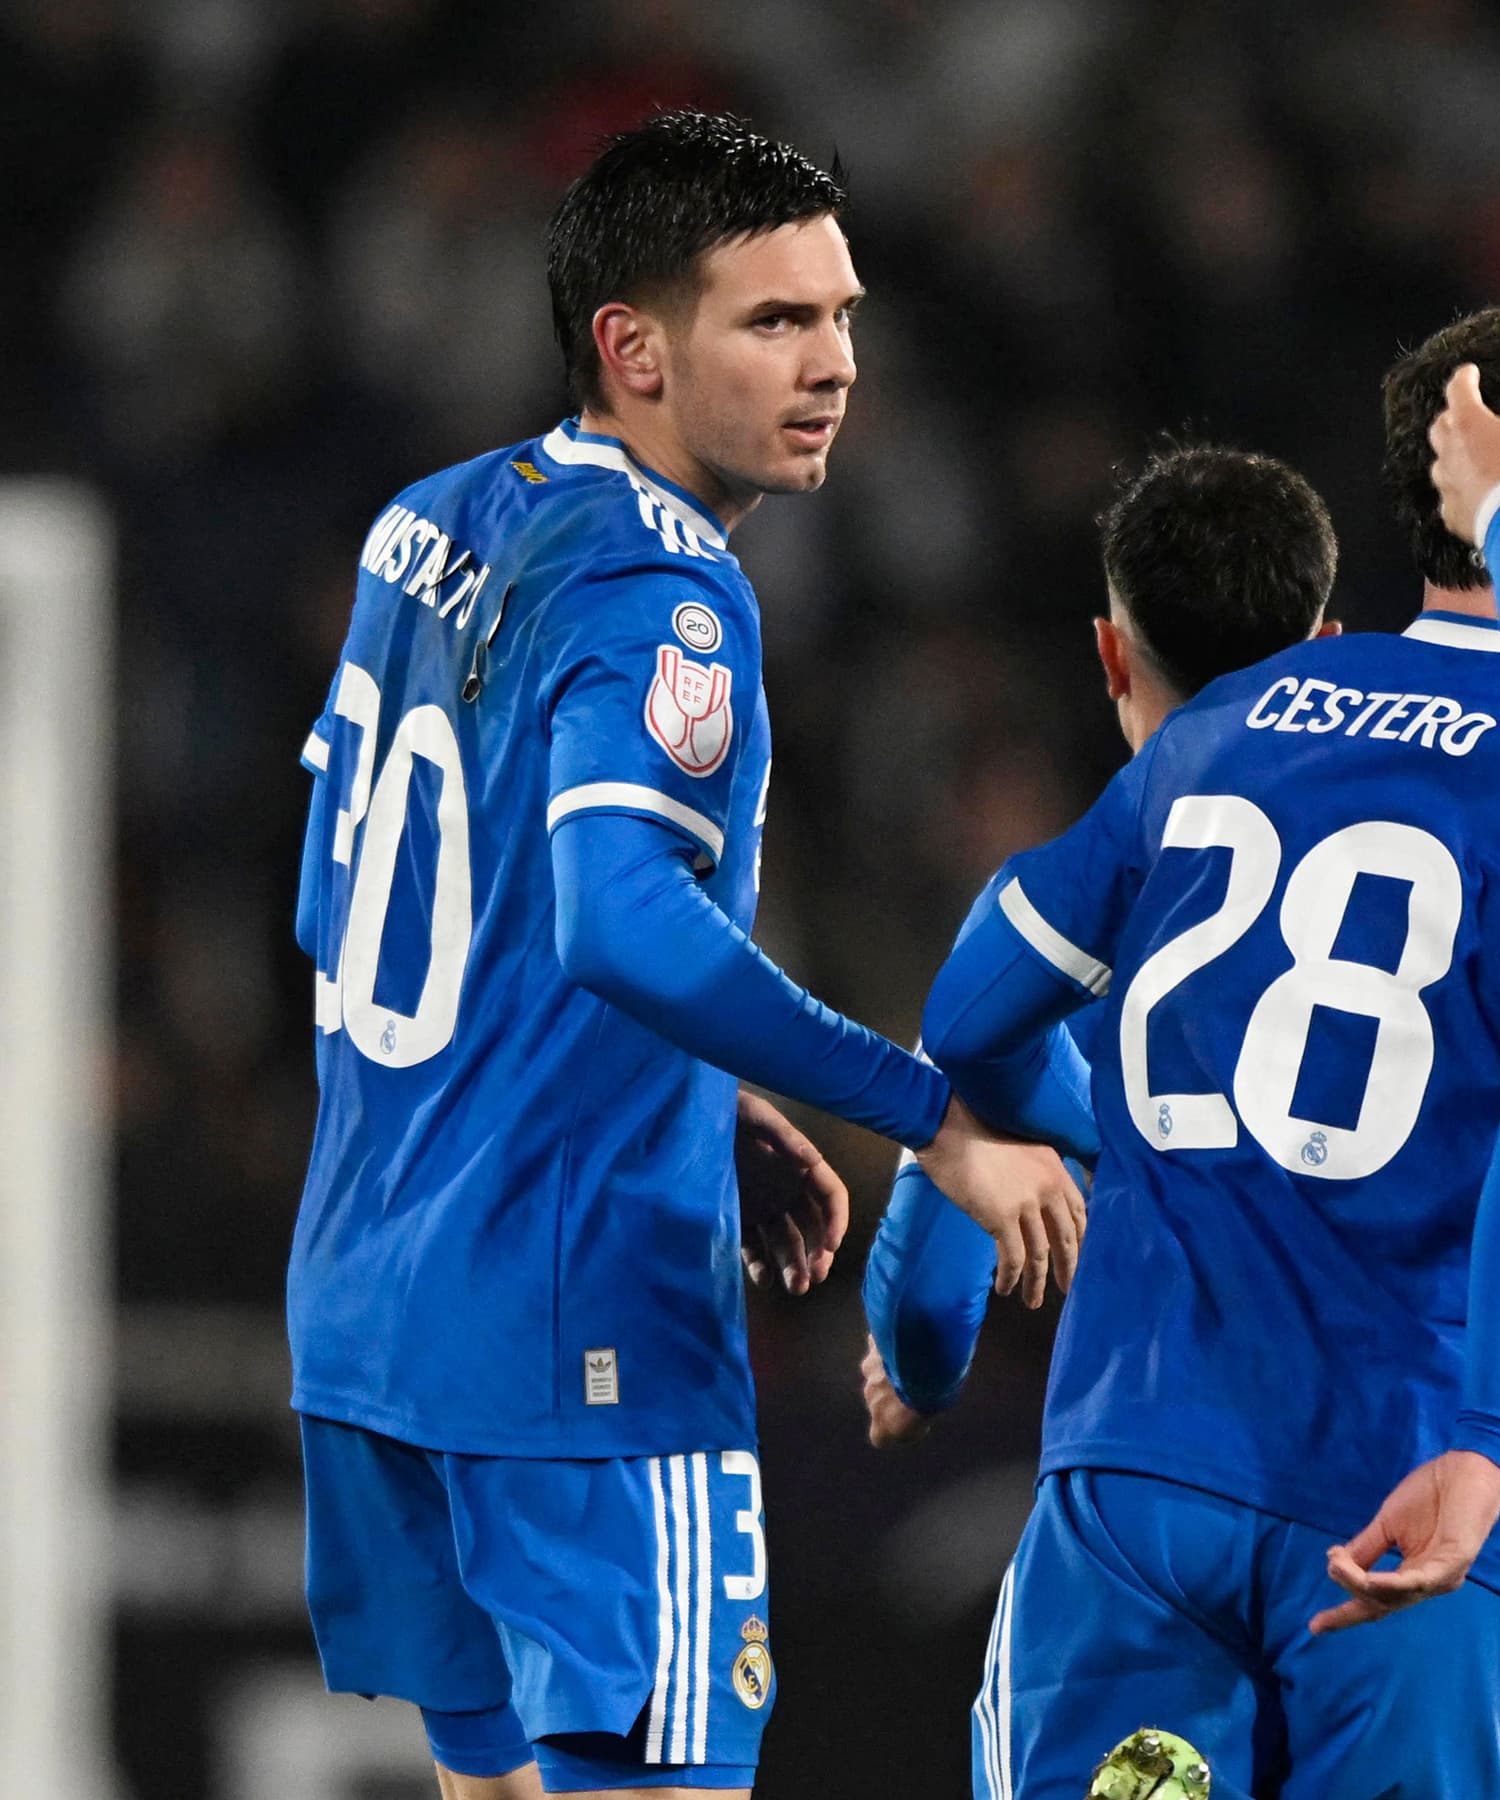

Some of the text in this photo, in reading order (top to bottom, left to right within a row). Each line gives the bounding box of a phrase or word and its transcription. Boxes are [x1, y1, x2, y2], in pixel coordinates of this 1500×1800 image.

[686, 618, 710, 635] 20
[1245, 676, 1498, 757] CESTERO
[1119, 794, 1463, 1181] 28
